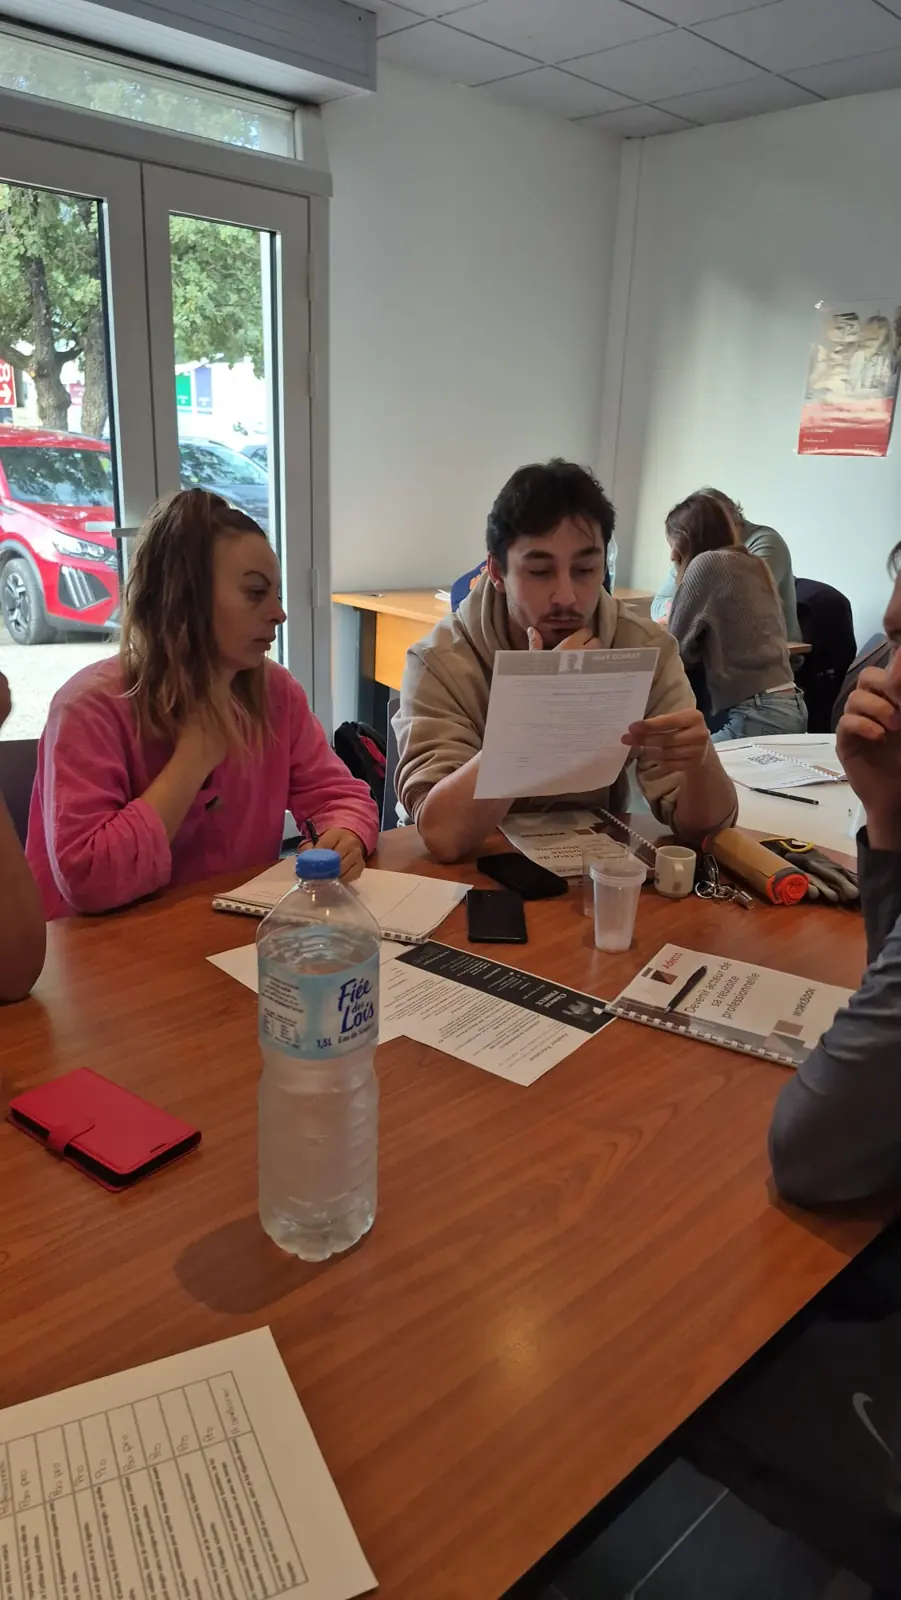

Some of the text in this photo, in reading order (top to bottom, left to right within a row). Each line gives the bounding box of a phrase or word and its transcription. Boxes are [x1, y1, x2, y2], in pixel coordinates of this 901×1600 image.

[662, 952, 683, 969] Adecco
[338, 977, 373, 1012] Fiée
[684, 961, 733, 1014] Devenir acteur de
[711, 999, 722, 1008] sa
[722, 971, 761, 1020] professionnelle
[340, 1001, 375, 1034] Lois
[316, 1037, 333, 1049] 1,5L
